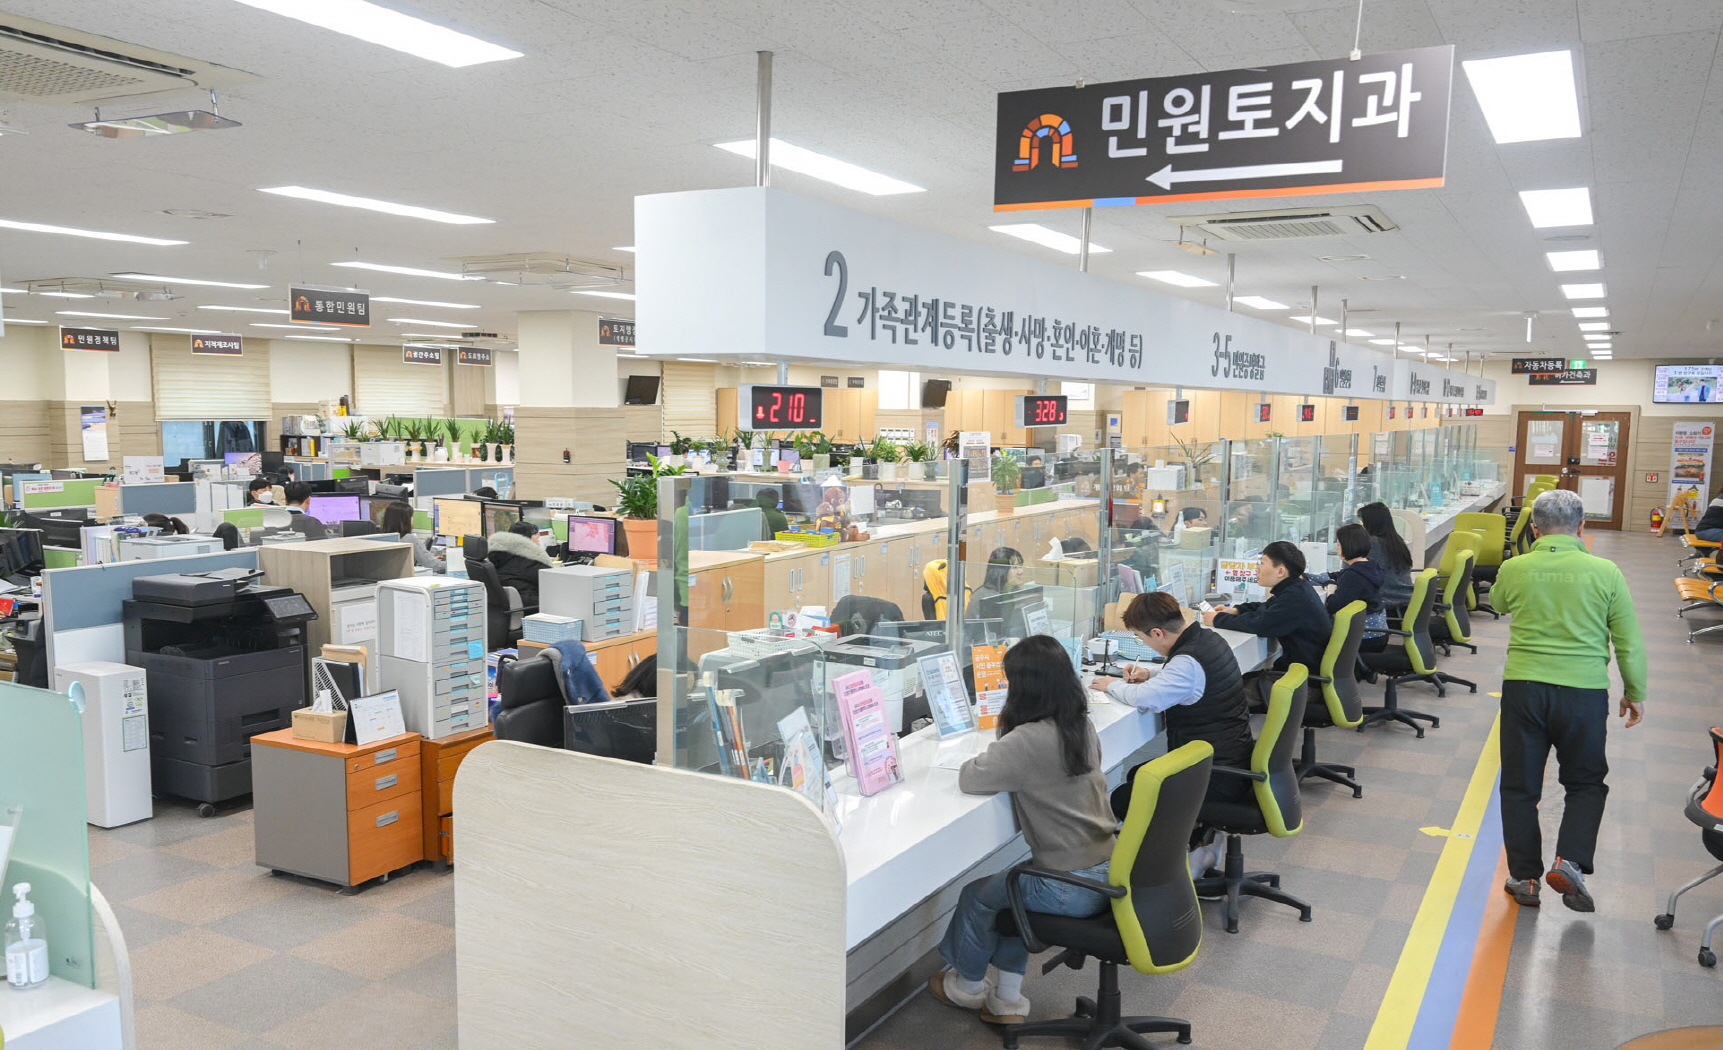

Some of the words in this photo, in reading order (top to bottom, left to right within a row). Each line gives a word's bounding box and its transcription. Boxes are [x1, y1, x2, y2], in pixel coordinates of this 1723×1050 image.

[1101, 62, 1422, 158] 민원토지과
[824, 250, 849, 338] 2
[314, 300, 365, 316] 통합민원팀
[77, 334, 117, 346] 민원정책팀
[204, 340, 240, 350] 지적재조사팀
[1211, 331, 1233, 379] 3-5
[1524, 360, 1563, 371] 자동차등록
[768, 392, 805, 423] 210
[1035, 400, 1057, 421] 328
